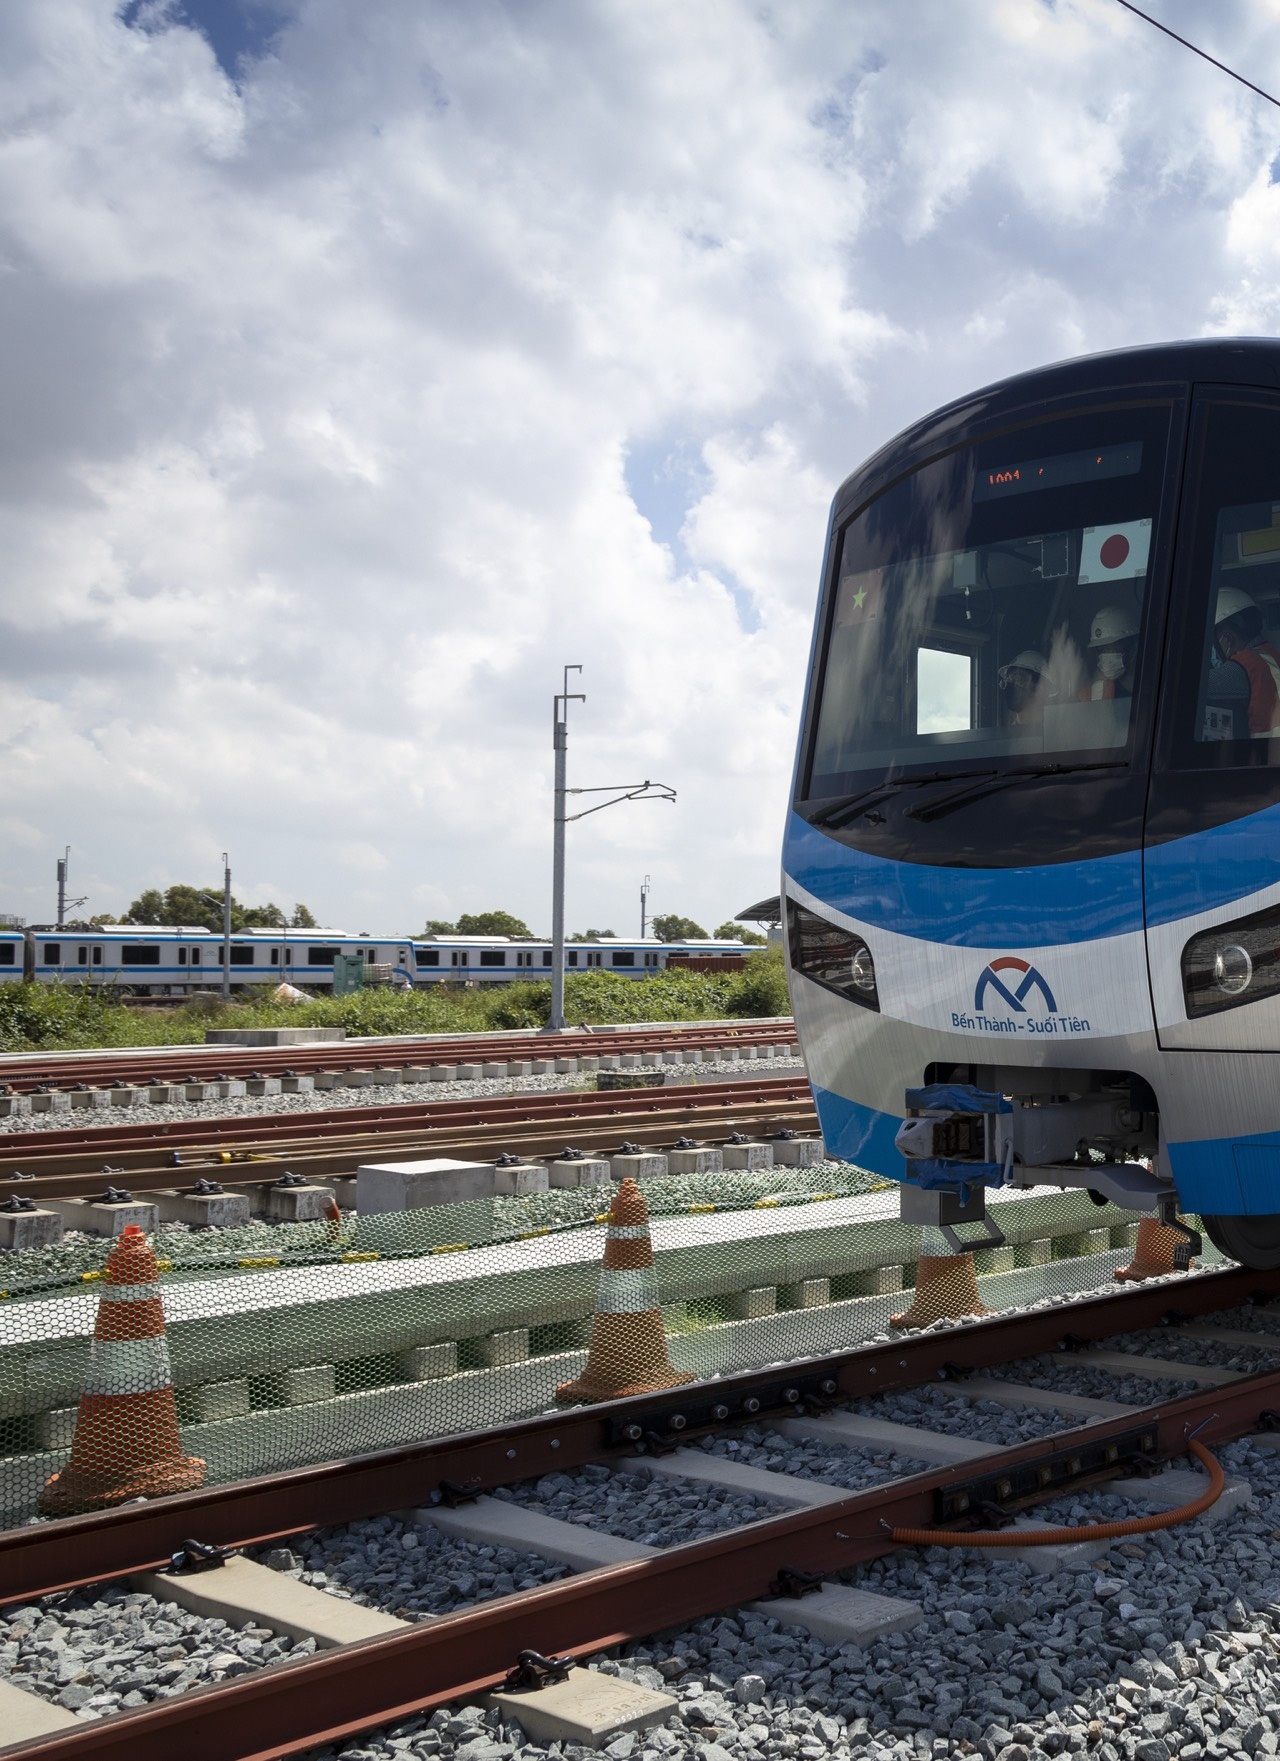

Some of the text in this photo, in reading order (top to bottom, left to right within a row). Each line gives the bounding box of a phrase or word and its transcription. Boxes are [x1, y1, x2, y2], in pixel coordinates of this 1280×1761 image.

[951, 1012, 975, 1030] Bến
[975, 1016, 1017, 1033] Thành
[1028, 1016, 1058, 1033] Suối
[1059, 1016, 1091, 1033] Tiên
